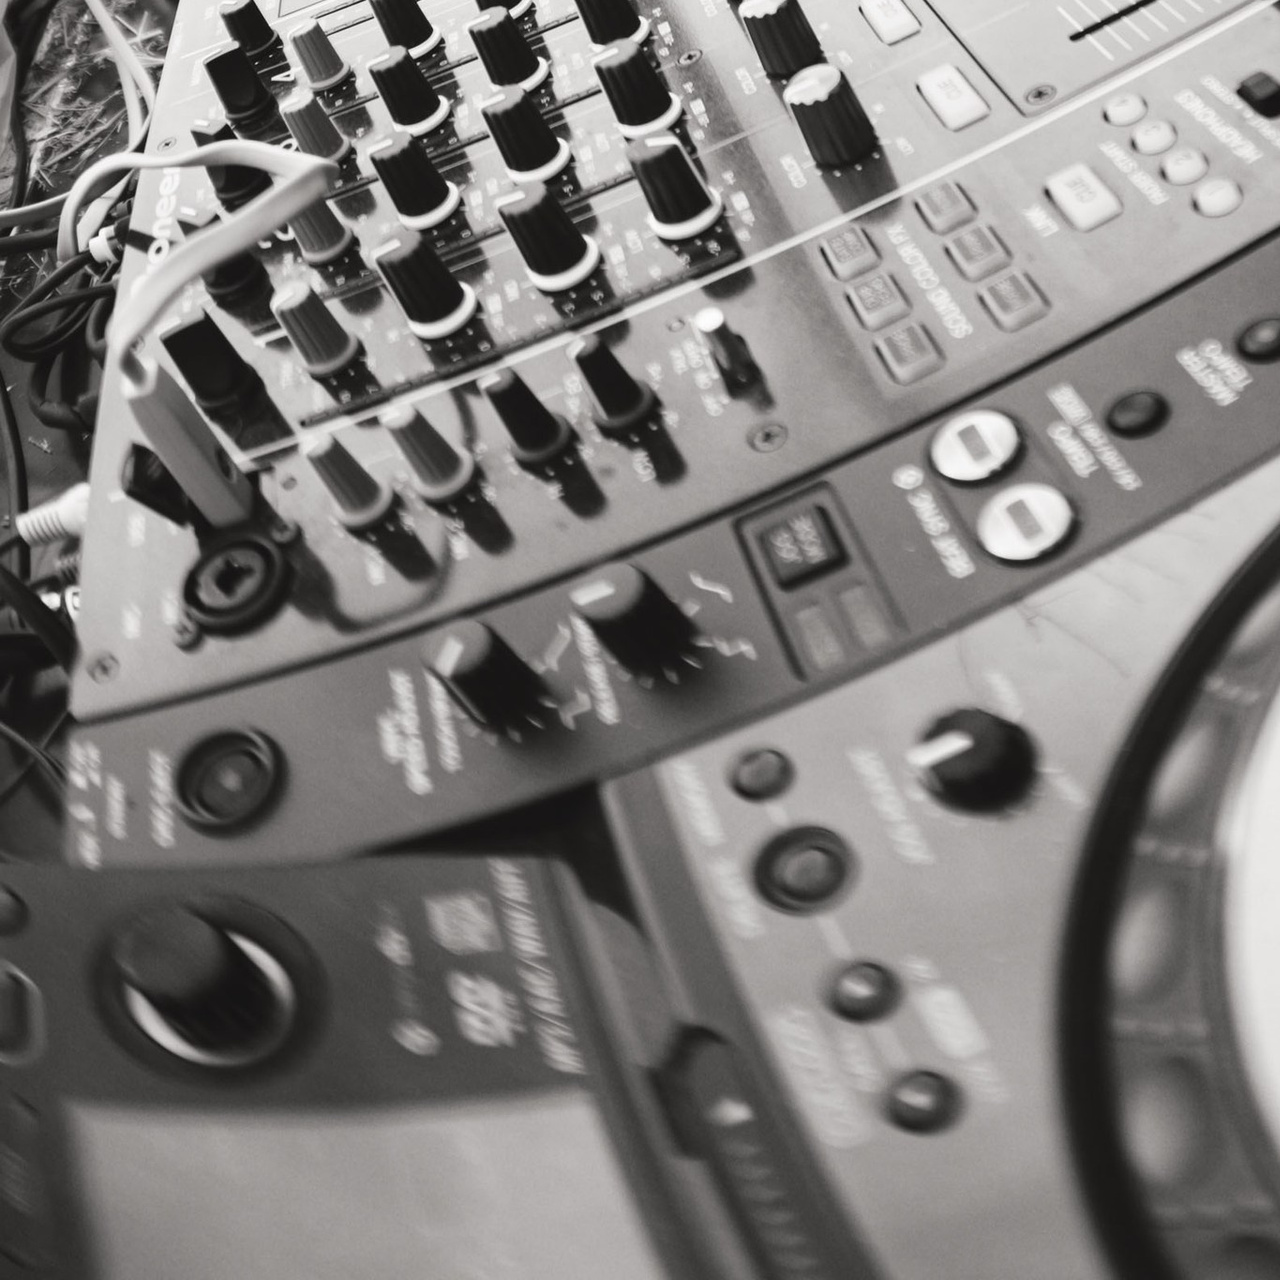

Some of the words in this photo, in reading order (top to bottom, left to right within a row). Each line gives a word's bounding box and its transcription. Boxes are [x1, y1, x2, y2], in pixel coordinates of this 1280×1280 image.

[1172, 88, 1263, 165] HEADPHONES
[779, 154, 808, 189] COLOR
[1096, 139, 1140, 176] START
[1064, 178, 1097, 204] CUE
[883, 220, 910, 246] FX
[1019, 202, 1059, 238] LINK
[895, 240, 940, 291] COLOR
[925, 284, 973, 339] SOUND
[1175, 346, 1239, 407] MASTER
[1197, 339, 1253, 392] TEMPO
